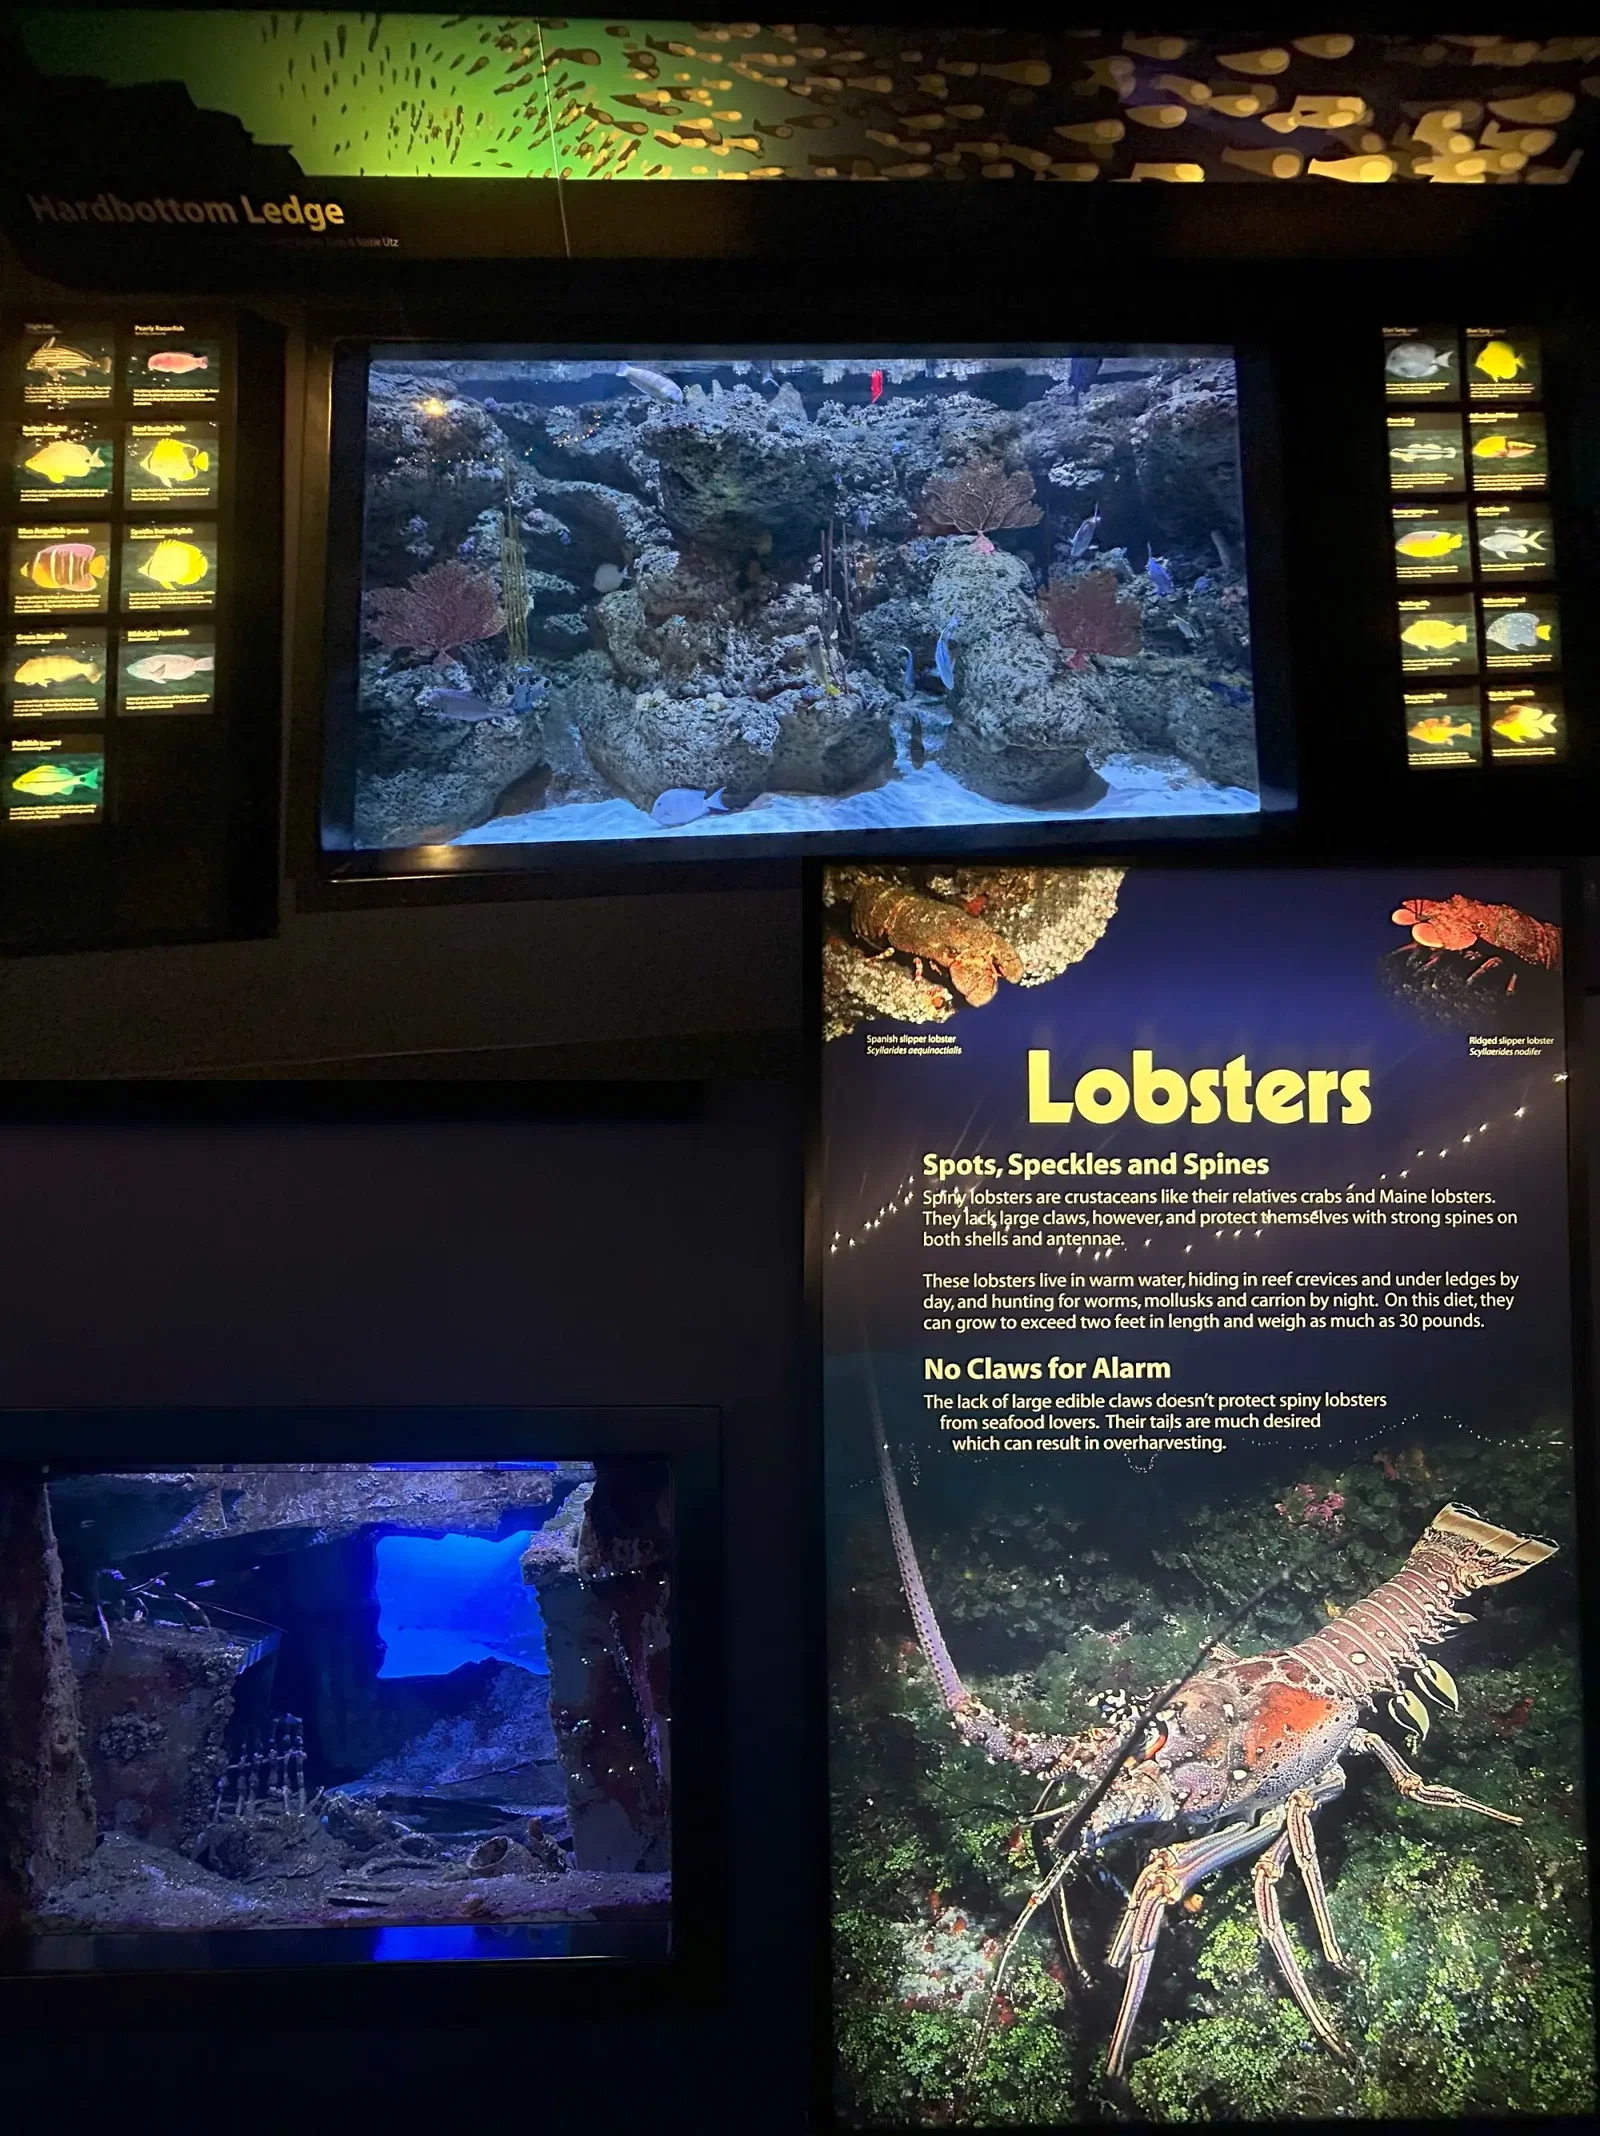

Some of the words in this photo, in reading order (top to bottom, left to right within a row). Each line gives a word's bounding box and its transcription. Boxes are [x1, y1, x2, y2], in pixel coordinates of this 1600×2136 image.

[27, 192, 239, 225] Hardbottom
[240, 194, 346, 232] Ledge
[866, 1034, 898, 1044] Spanish
[899, 1034, 927, 1044] slipper
[928, 1034, 957, 1044] lobster
[1469, 1036, 1498, 1046] Ridged
[1498, 1036, 1525, 1046] slipper
[1526, 1036, 1554, 1045] lobster
[1028, 1049, 1372, 1125] Lobsters
[923, 1153, 1004, 1181] Spots,
[1007, 1152, 1123, 1181] Speckles
[1127, 1151, 1177, 1176] and
[1183, 1151, 1270, 1181] Spines
[921, 1188, 967, 1209] Spiny
[969, 1188, 1033, 1205] lobsters
[1035, 1192, 1062, 1205] are
[1063, 1190, 1158, 1205] crustaceans
[1160, 1187, 1189, 1204] like
[1191, 1187, 1230, 1204] their
[1232, 1188, 1298, 1204] relatives
[1299, 1188, 1343, 1204] crabs
[1345, 1188, 1376, 1204] and
[1379, 1188, 1428, 1204] Maine
[1431, 1188, 1496, 1204] lobsters.
[921, 1209, 962, 1230] They
[964, 1209, 996, 1226] lack
[999, 1209, 1040, 1230] large
[1042, 1209, 1091, 1228] claws,
[1092, 1209, 1164, 1227] however,
[1165, 1209, 1196, 1225] and
[1200, 1210, 1258, 1228] protect
[1260, 1208, 1349, 1225] themselves
[1351, 1208, 1387, 1225] with
[1390, 1211, 1441, 1228] strong
[1444, 1209, 1494, 1228] spines
[1497, 1213, 1518, 1224] on
[923, 1230, 961, 1247] both
[964, 1230, 1010, 1247] shells
[1012, 1230, 1043, 1247] and
[1046, 1233, 1127, 1247] antennae.
[922, 1272, 970, 1289] These
[973, 1272, 1036, 1288] lobsters
[1039, 1272, 1067, 1288] live
[1070, 1272, 1086, 1288] in
[1088, 1275, 1135, 1288] warm
[1137, 1274, 1186, 1289] water,
[1188, 1271, 1239, 1291] hiding
[1242, 1271, 1258, 1287] in
[1261, 1270, 1294, 1287] reef
[1295, 1271, 1358, 1287] crevices
[1361, 1271, 1391, 1287] and
[1395, 1271, 1442, 1287] under
[1445, 1270, 1497, 1290] ledges
[1500, 1271, 1520, 1290] by
[923, 1293, 955, 1313] day,
[957, 1293, 988, 1309] and
[991, 1293, 1055, 1312] hunting
[1057, 1292, 1081, 1309] for
[1083, 1296, 1142, 1310] worms,
[1144, 1292, 1214, 1308] mollusks
[1216, 1291, 1247, 1308] and
[1250, 1292, 1306, 1308] carrion
[1309, 1291, 1330, 1311] by
[1333, 1291, 1379, 1311] night.
[1384, 1292, 1408, 1307] On
[1411, 1291, 1440, 1307] this
[1443, 1291, 1478, 1309] diet,
[1479, 1291, 1515, 1311] they
[923, 1317, 952, 1330] can
[955, 1318, 997, 1334] grow
[999, 1316, 1018, 1330] to
[1020, 1313, 1077, 1330] exceed
[1079, 1315, 1112, 1329] two
[1114, 1313, 1146, 1329] feet
[1149, 1313, 1165, 1329] in
[1168, 1312, 1220, 1332] length
[1223, 1312, 1254, 1329] and
[1257, 1312, 1306, 1332] weigh
[1309, 1316, 1327, 1328] as
[1330, 1312, 1375, 1328] much
[1378, 1316, 1396, 1328] as
[1399, 1313, 1419, 1328] 30
[1422, 1312, 1485, 1331] pounds.
[924, 1358, 961, 1380] No
[967, 1356, 1043, 1380] Claws
[1047, 1356, 1087, 1380] for
[1091, 1356, 1171, 1379] Alarm
[923, 1393, 954, 1409] The
[957, 1393, 989, 1409] lack
[991, 1393, 1010, 1409] of
[1012, 1393, 1052, 1413] large
[1055, 1392, 1106, 1409] edible
[1108, 1392, 1153, 1408] claws
[1218, 1394, 1277, 1411] protect
[1279, 1392, 1322, 1411] spiny
[1325, 1391, 1387, 1407] lobsters
[939, 1414, 978, 1430] from
[981, 1413, 1045, 1430] seafood
[1049, 1414, 1100, 1430] lovers.
[1104, 1413, 1147, 1429] Their
[1149, 1413, 1182, 1430] tails
[1185, 1417, 1211, 1429] are
[1214, 1412, 1260, 1429] much
[1263, 1412, 1321, 1428] desired
[952, 1435, 1001, 1451] which
[1003, 1439, 1033, 1451] can
[1036, 1434, 1082, 1451] result
[1084, 1435, 1100, 1450] in
[1103, 1434, 1227, 1454] overharvesting.
